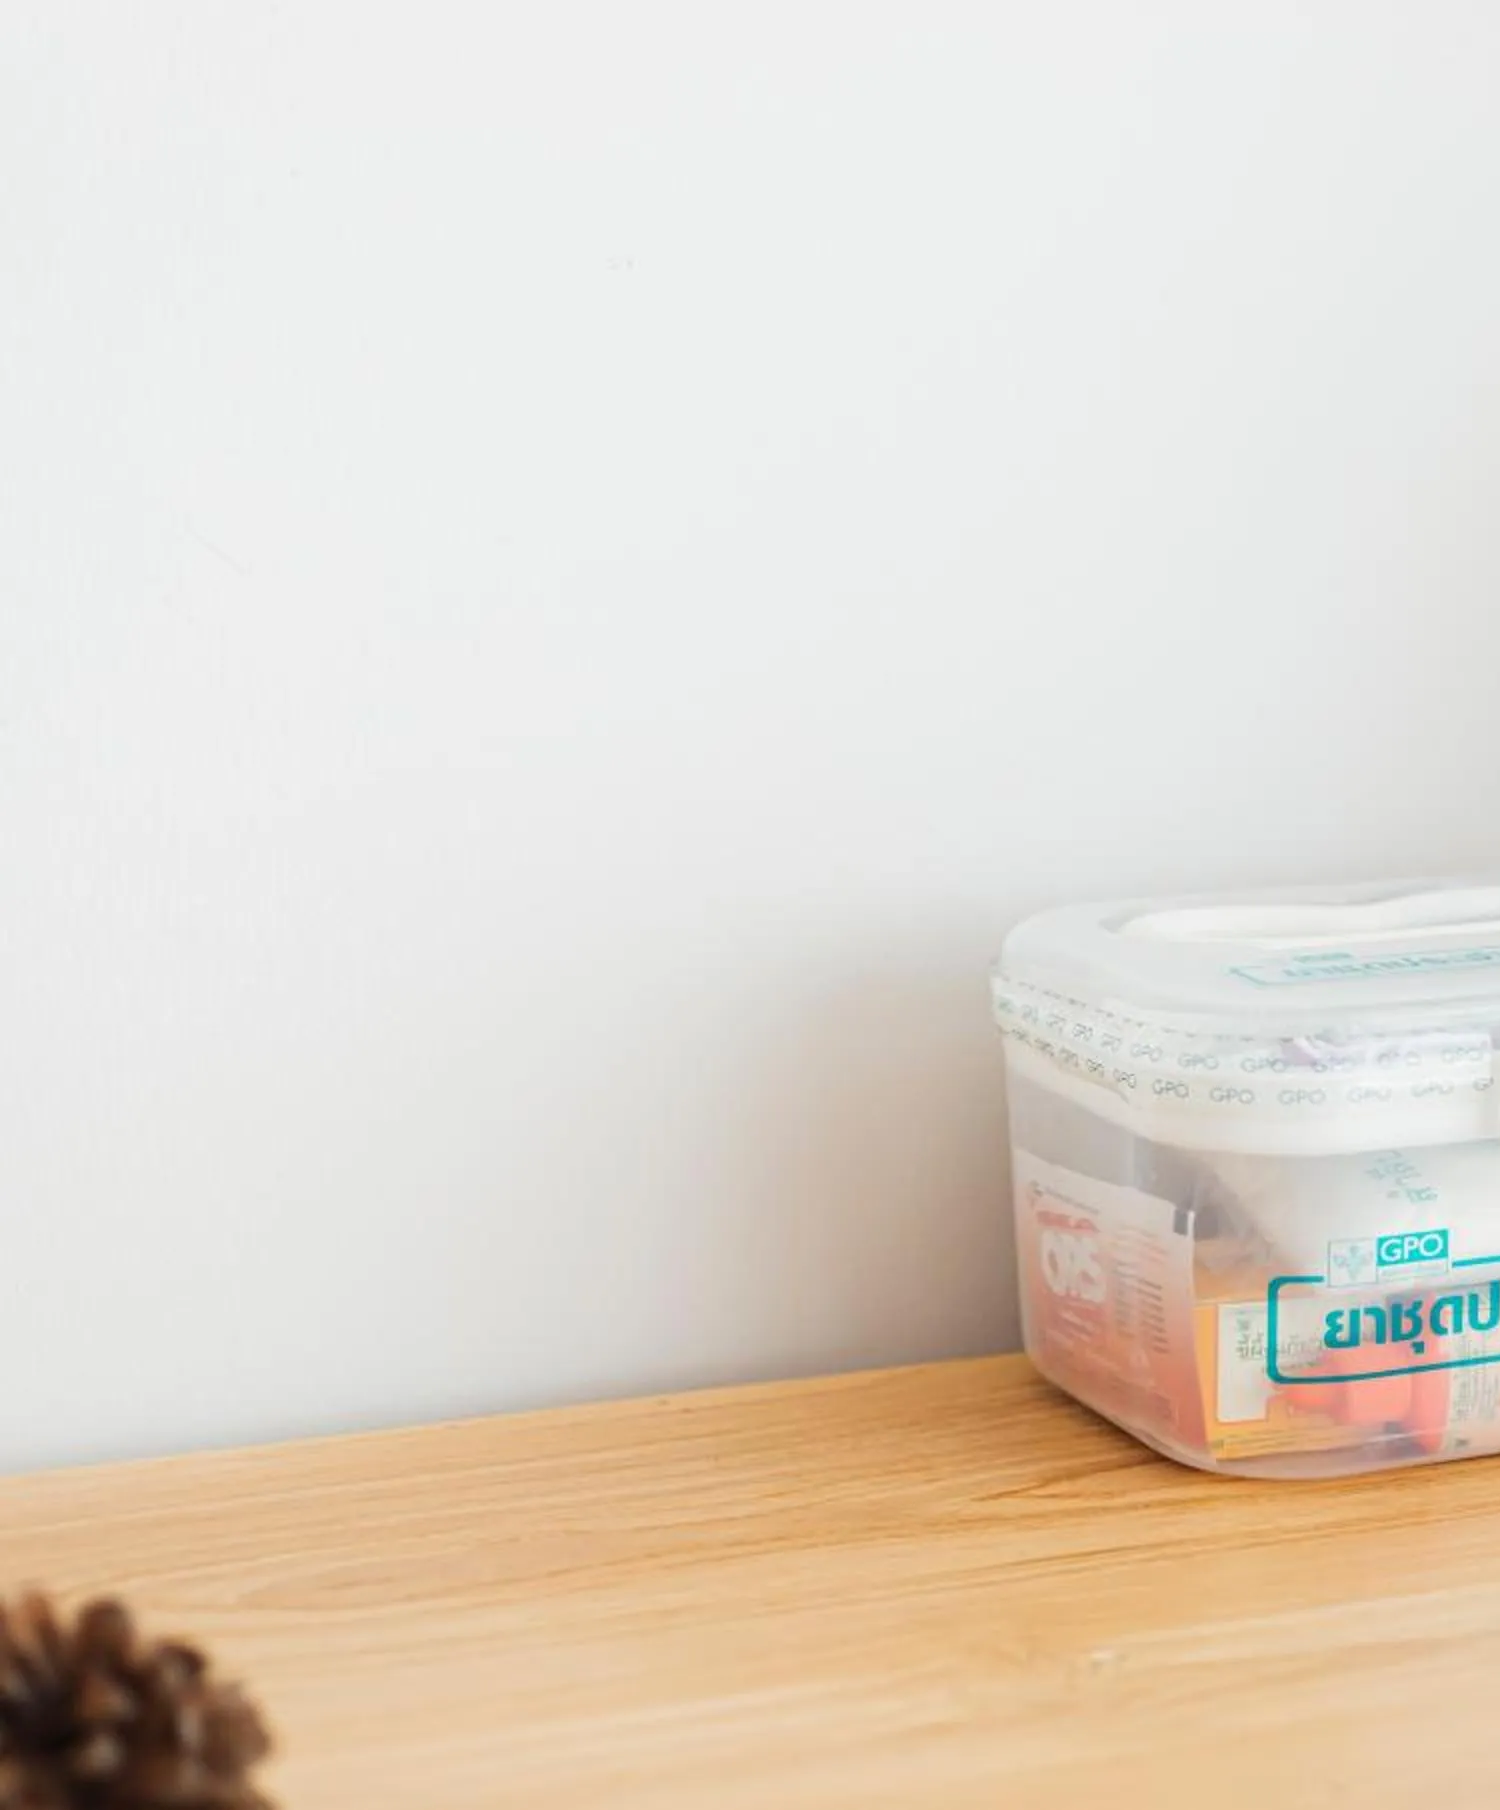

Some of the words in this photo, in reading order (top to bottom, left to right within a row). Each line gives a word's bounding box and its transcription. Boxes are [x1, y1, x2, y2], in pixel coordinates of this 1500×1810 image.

[1177, 1052, 1219, 1070] GPO
[1240, 1057, 1287, 1073] GPO
[1152, 1079, 1189, 1099] GPO
[1210, 1087, 1255, 1105] GPO
[1278, 1088, 1326, 1104] GPO
[1348, 1085, 1390, 1102] GPO
[1380, 1233, 1444, 1263] GPO
[1040, 1229, 1108, 1304] ORS
